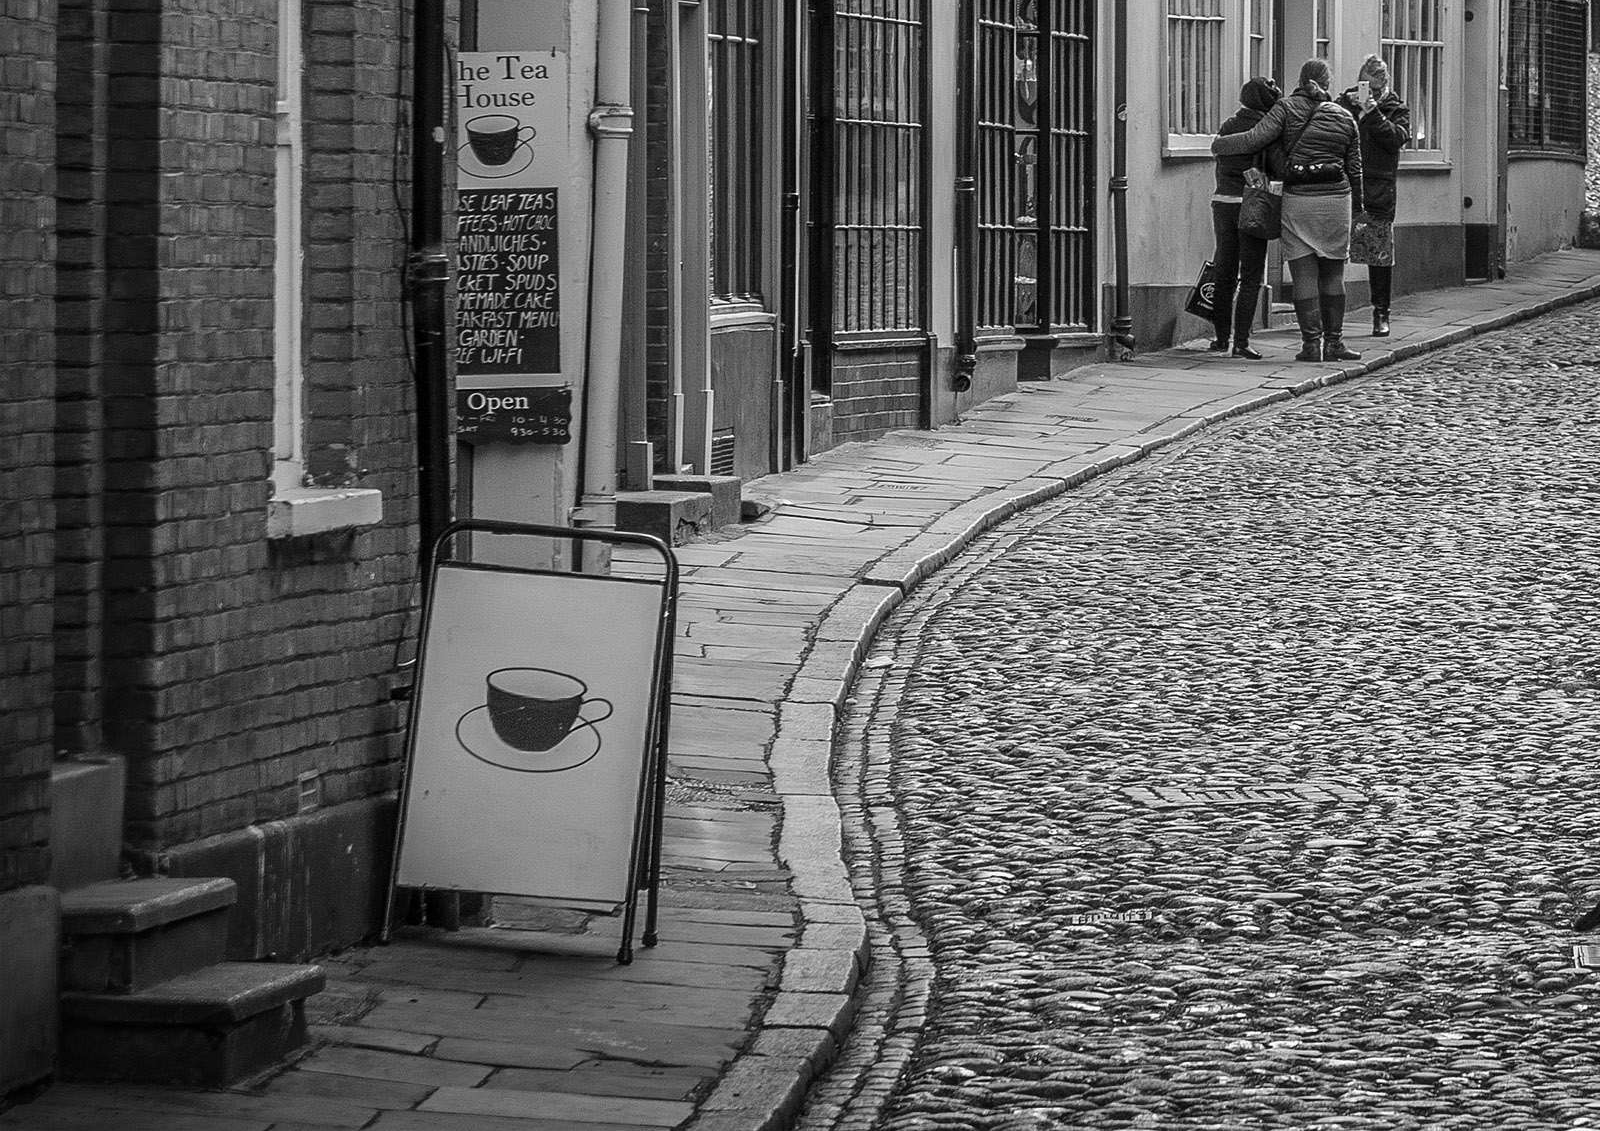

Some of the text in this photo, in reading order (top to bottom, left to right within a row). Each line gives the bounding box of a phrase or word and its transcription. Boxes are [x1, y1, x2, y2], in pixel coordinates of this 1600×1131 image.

[458, 55, 549, 81] he Tea
[481, 193, 517, 212] LEAF
[518, 192, 554, 211] TEAS
[458, 214, 497, 232] FFEES
[460, 234, 541, 253] ANDWICHES
[457, 254, 549, 272] STIES SOUP
[457, 274, 557, 291] CKET SPUDS
[456, 292, 554, 309] MEMADE CAKE
[455, 311, 559, 328] EAKFAST MENU
[481, 348, 522, 365] WI-FI
[467, 393, 529, 414] Open
